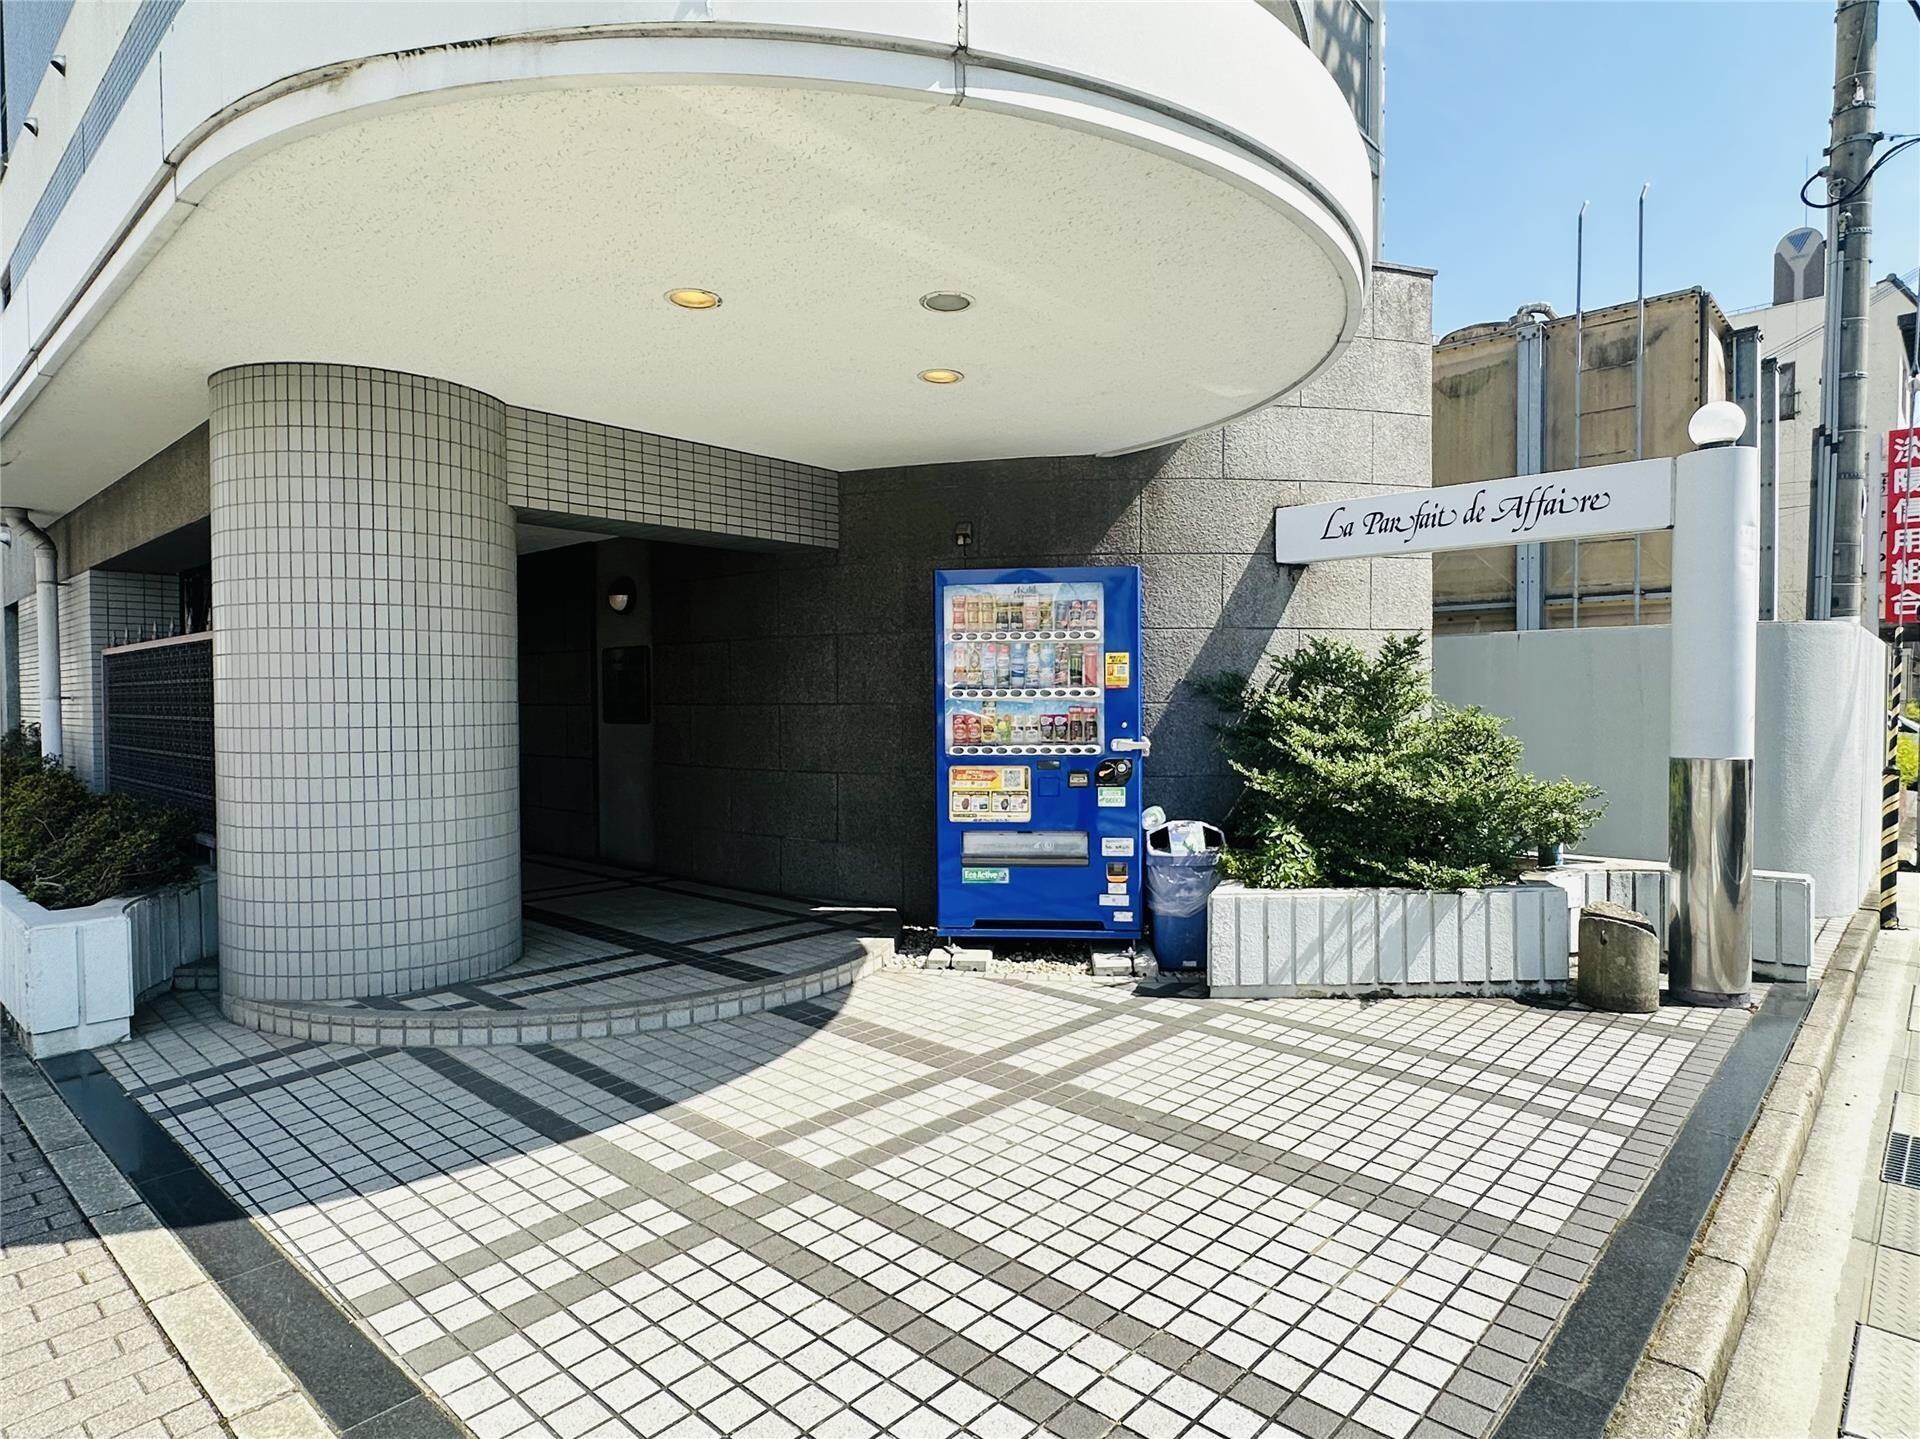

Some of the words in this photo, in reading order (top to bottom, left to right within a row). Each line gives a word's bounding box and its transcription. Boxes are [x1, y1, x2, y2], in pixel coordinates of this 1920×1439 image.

[1320, 507, 1354, 540] La
[1363, 500, 1457, 543] Parfait
[1462, 489, 1486, 523] de
[1491, 484, 1611, 533] Affaire
[964, 870, 977, 879] Eco
[977, 870, 998, 879] Active
